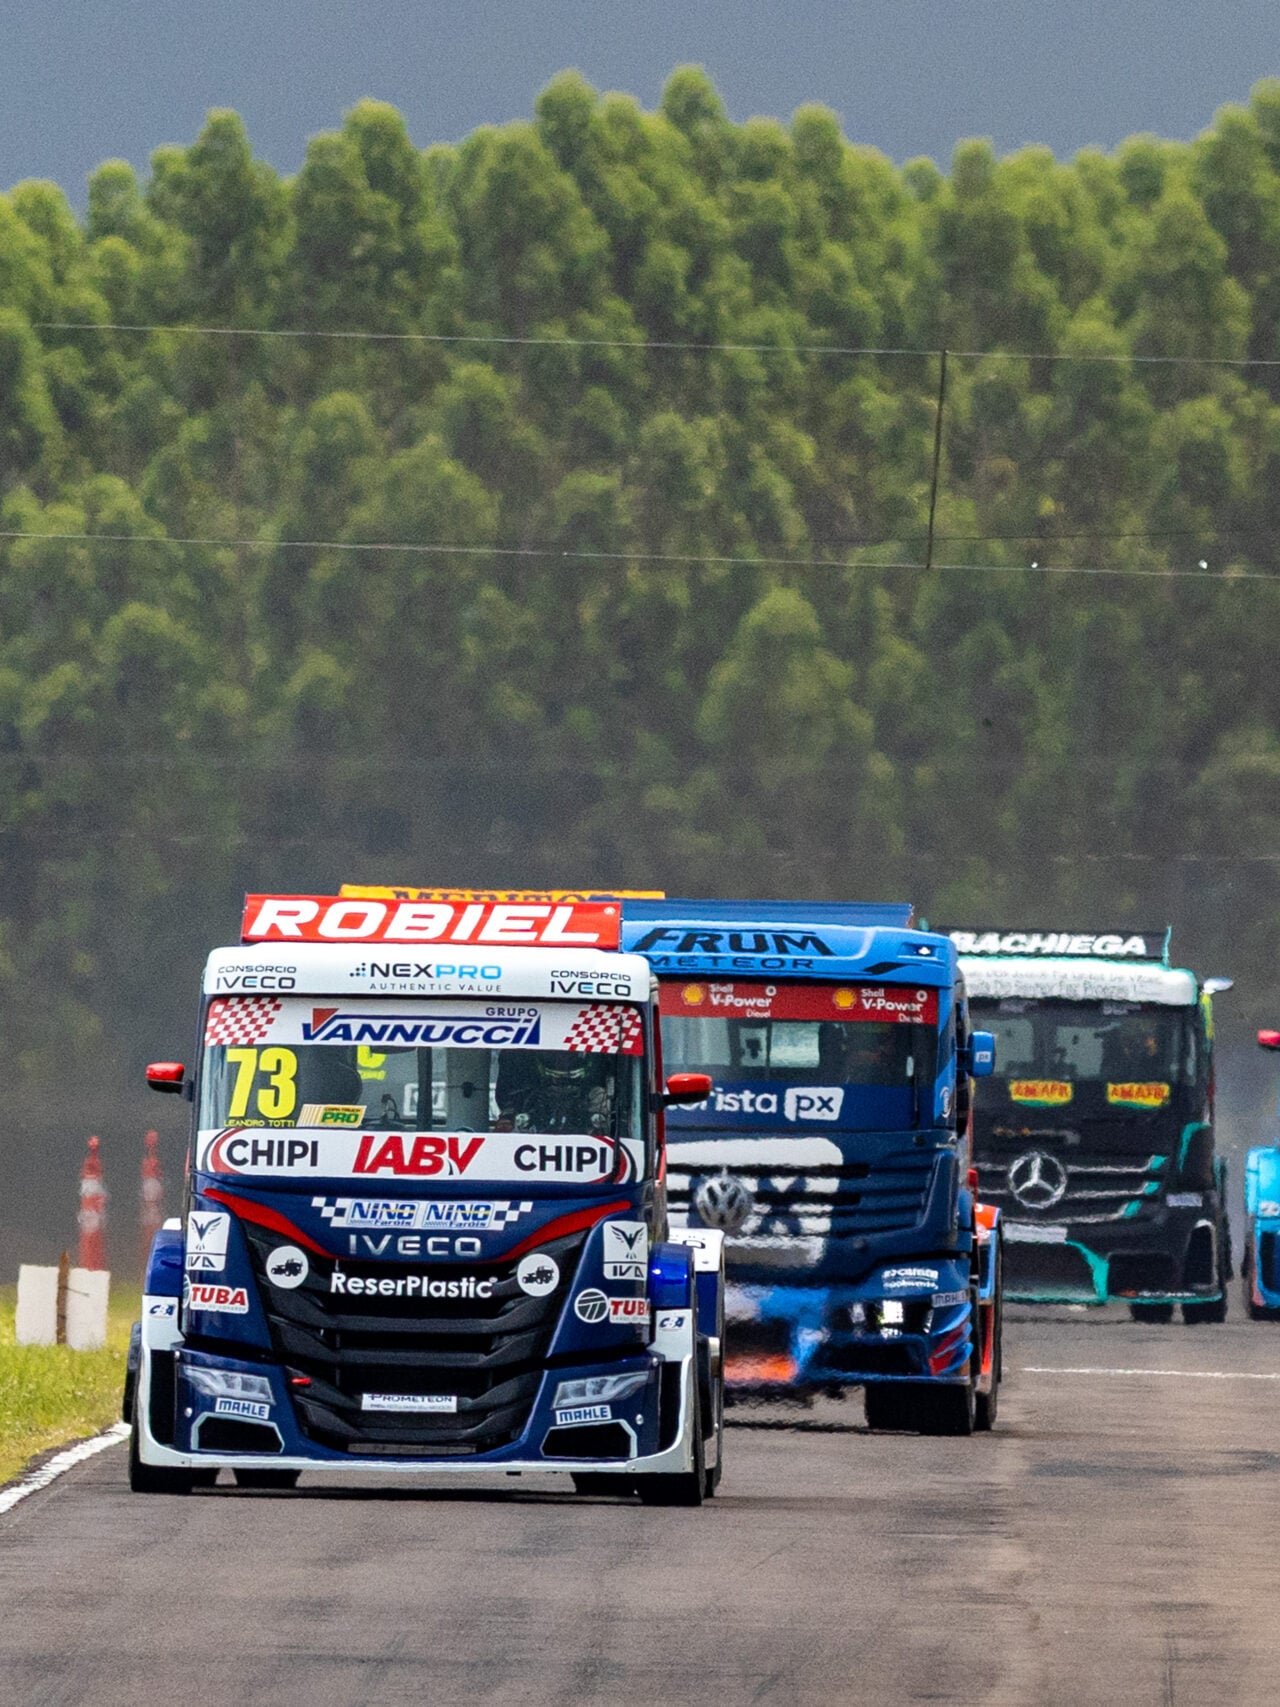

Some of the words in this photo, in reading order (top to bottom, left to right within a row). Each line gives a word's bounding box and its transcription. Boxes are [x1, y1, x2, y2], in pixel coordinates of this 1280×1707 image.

[248, 899, 600, 943] ROBIEL
[631, 927, 837, 957] FRUM
[217, 964, 297, 974] CONSÓRCIO
[370, 962, 502, 980] NEXPRO
[649, 956, 815, 970] METEOR
[216, 975, 296, 990] IVECO
[550, 969, 632, 982] CONSÓRCIO
[369, 983, 452, 991] AUTHENTIC
[459, 984, 502, 992] VALUE
[550, 980, 631, 997] IVECO
[708, 983, 734, 993] Shell
[861, 988, 885, 998] Shell
[709, 993, 773, 1008] V-Power
[861, 998, 923, 1013] V-Power
[485, 1007, 538, 1018] GRUPO
[302, 1014, 541, 1045] VANNUCCI
[227, 1047, 298, 1120] 73
[223, 1119, 265, 1128] LEANDRO
[268, 1119, 295, 1128] TOTTI
[321, 1111, 359, 1124] PRO
[226, 1138, 319, 1167] CHIPI
[352, 1135, 486, 1175] IABV
[514, 1144, 608, 1174] CHIPI
[349, 1233, 482, 1257] IVECO
[330, 1271, 493, 1299] ReserPlastic
[191, 1286, 247, 1306] TUBA
[218, 1399, 267, 1417] MAHLE
[559, 1406, 608, 1423] MAHLE
